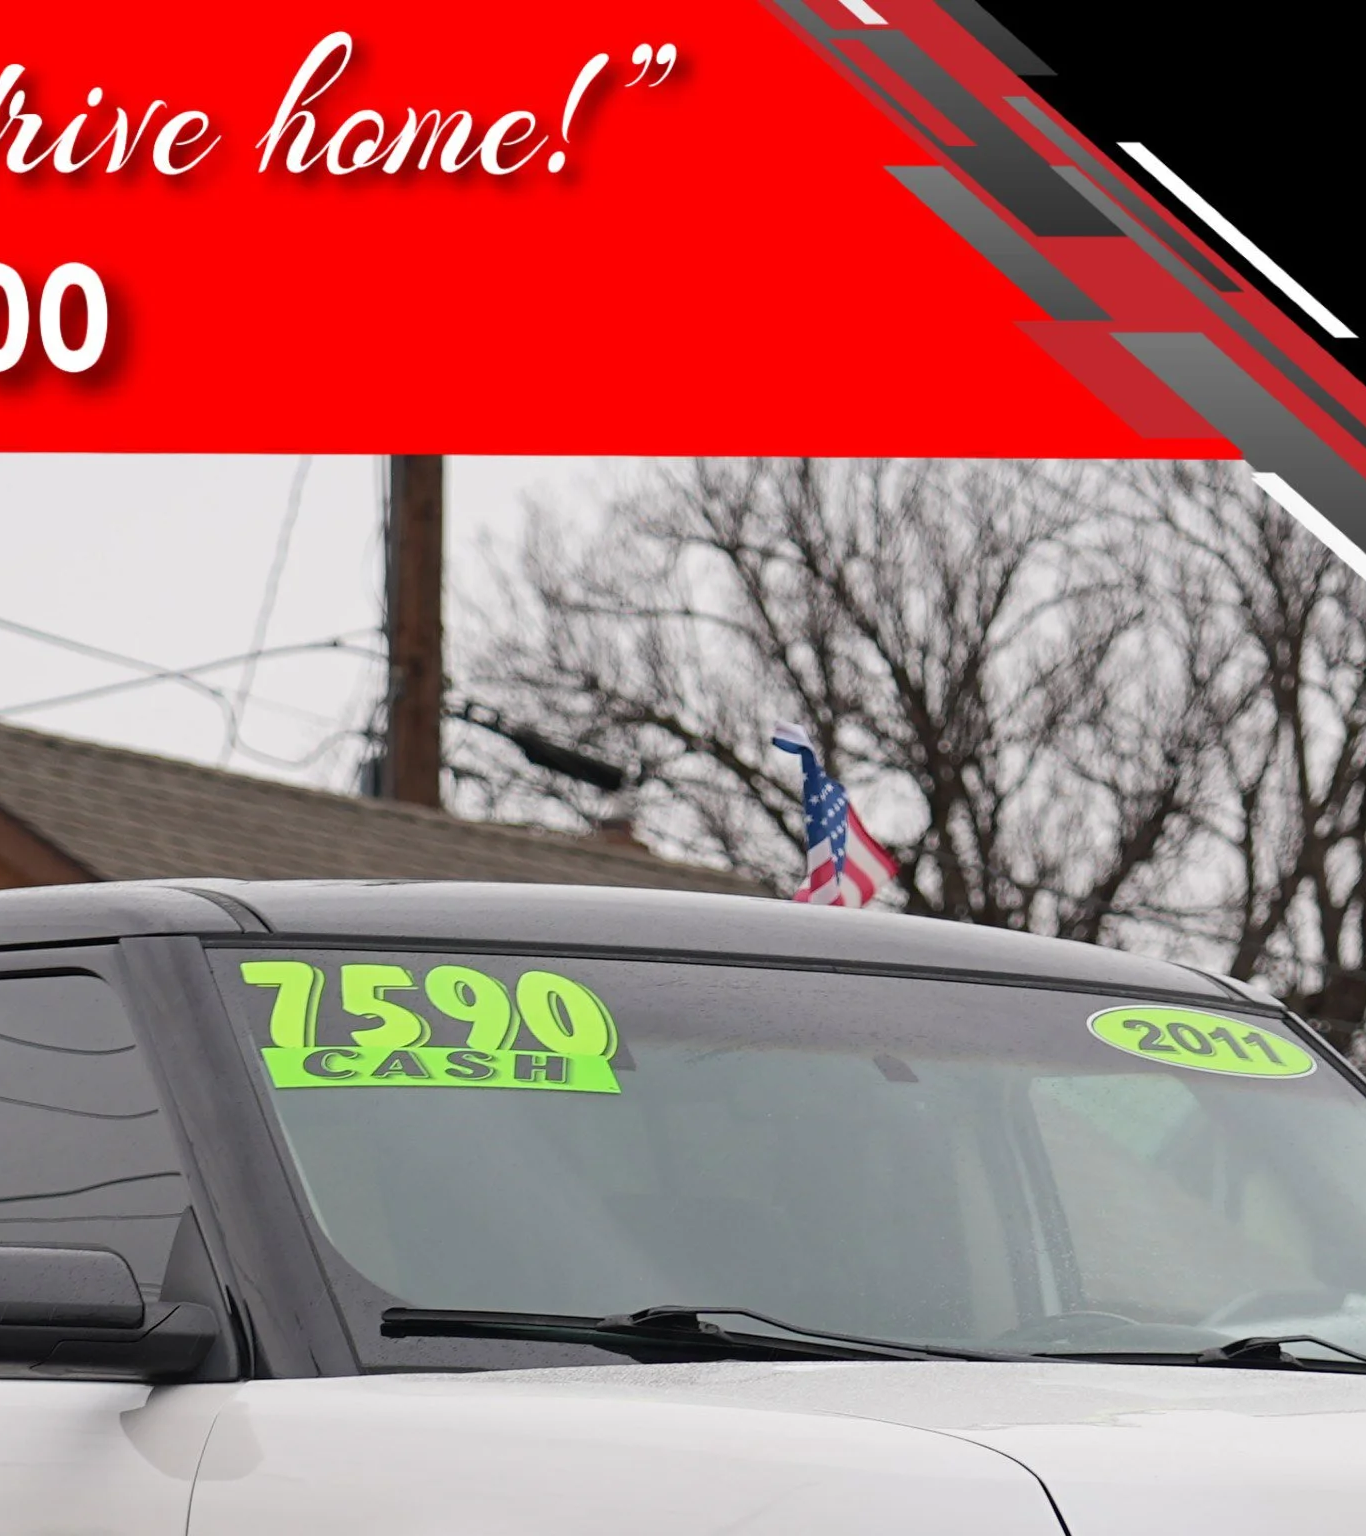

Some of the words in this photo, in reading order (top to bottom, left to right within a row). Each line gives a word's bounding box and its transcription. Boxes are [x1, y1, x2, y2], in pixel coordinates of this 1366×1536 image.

[239, 960, 619, 1060] 7590
[301, 1049, 573, 1085] CASH
[1122, 1018, 1288, 1067] 2011
